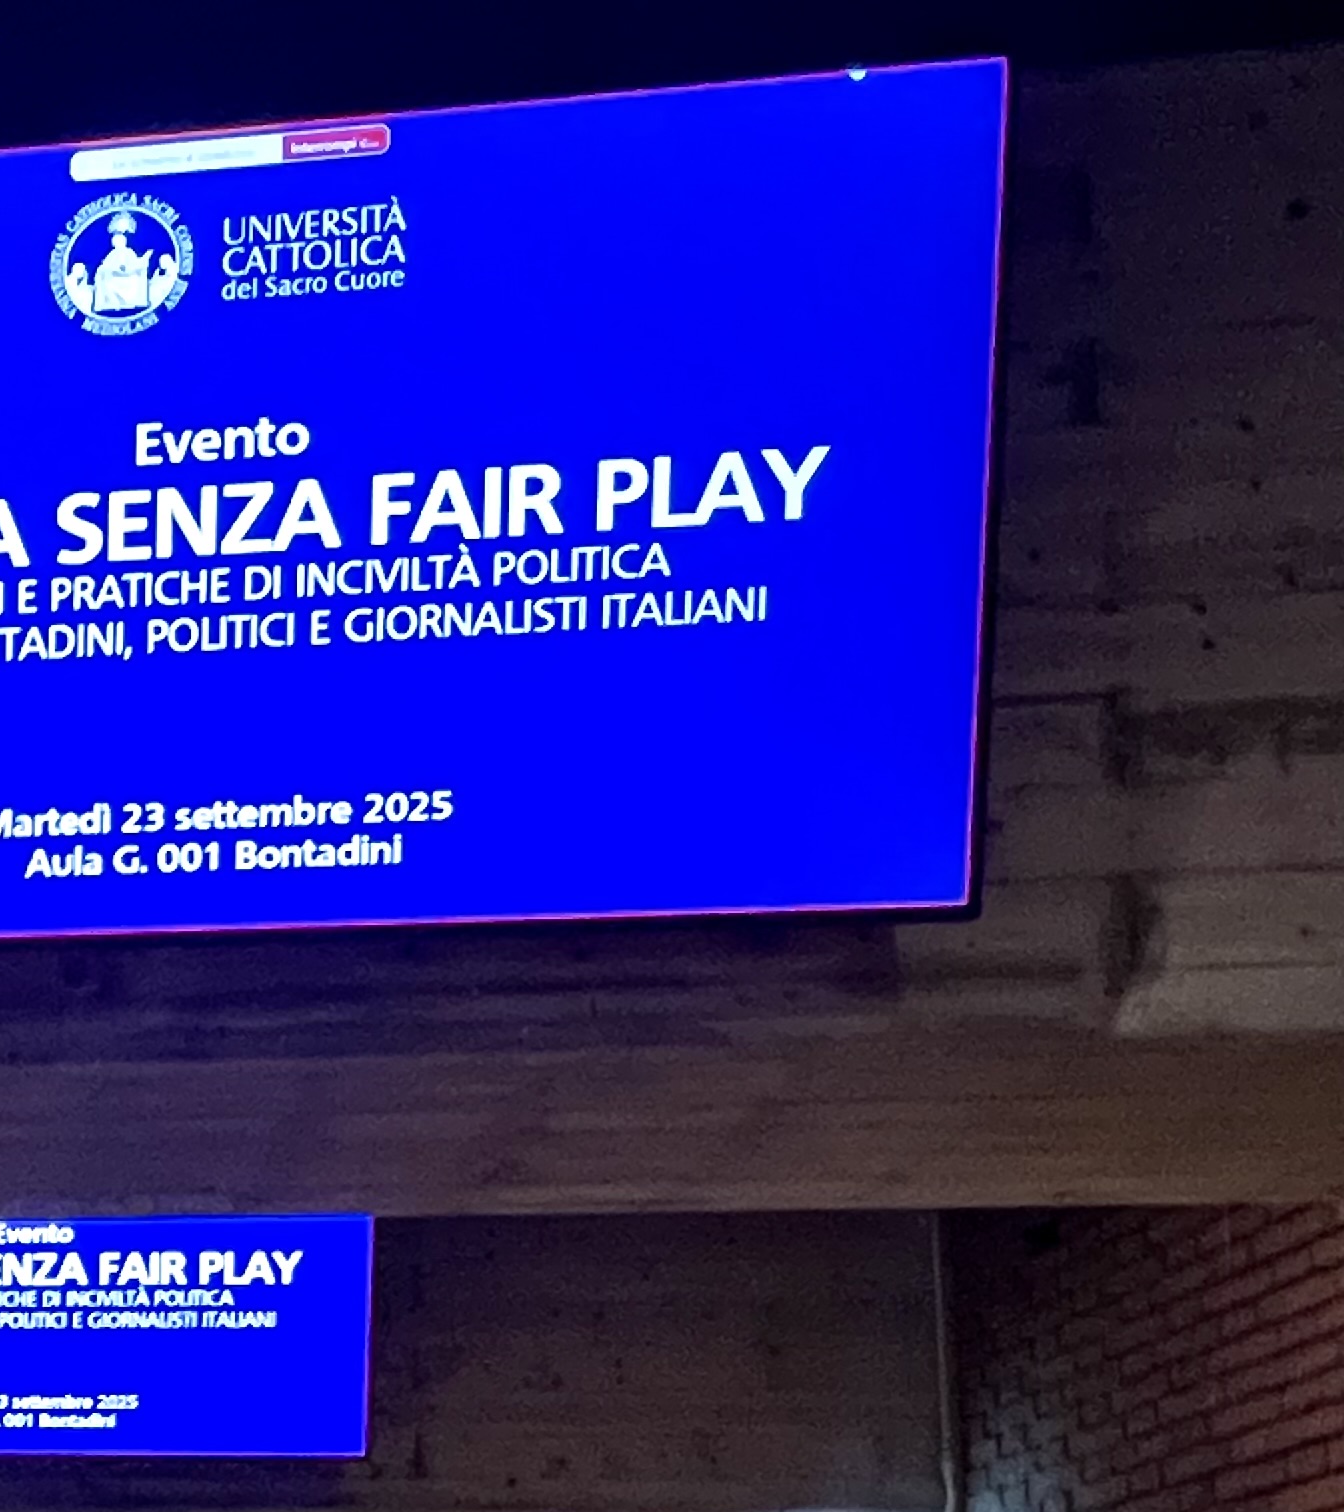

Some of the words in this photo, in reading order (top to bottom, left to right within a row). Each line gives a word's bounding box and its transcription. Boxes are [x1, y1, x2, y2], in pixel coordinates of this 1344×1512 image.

[223, 195, 408, 246] UNIVERSITÀ
[222, 234, 406, 278] CATTOLICA
[220, 277, 258, 301] del
[264, 276, 328, 298] Sacro
[334, 269, 406, 292] Cuore
[135, 416, 310, 467] Evento
[56, 478, 342, 566] SENZA
[370, 463, 565, 546] FAIR
[596, 445, 831, 532] PLAY
[17, 578, 38, 615] E
[50, 566, 231, 613] PRATICHE
[244, 564, 282, 602] DI
[296, 545, 482, 598] INCIVILTÀ
[492, 542, 672, 587] POLITICA
[146, 612, 296, 654] POLITICI
[310, 609, 332, 646] E
[344, 595, 588, 643] GIORNALISTI
[602, 585, 768, 630] ITALIANI
[120, 802, 166, 834] 23
[174, 794, 354, 832] settembre
[362, 790, 454, 824] 2025
[24, 844, 104, 880] Aula
[112, 844, 149, 875] G.
[156, 840, 220, 874] 001
[234, 833, 403, 870] Bontadini
[98, 1250, 188, 1288] FAIR
[198, 1250, 304, 1286] PLAY
[42, 1290, 62, 1308] DI
[153, 1288, 235, 1307] POLITICA
[72, 1310, 84, 1329] E
[200, 1310, 278, 1329] ITALIANI
